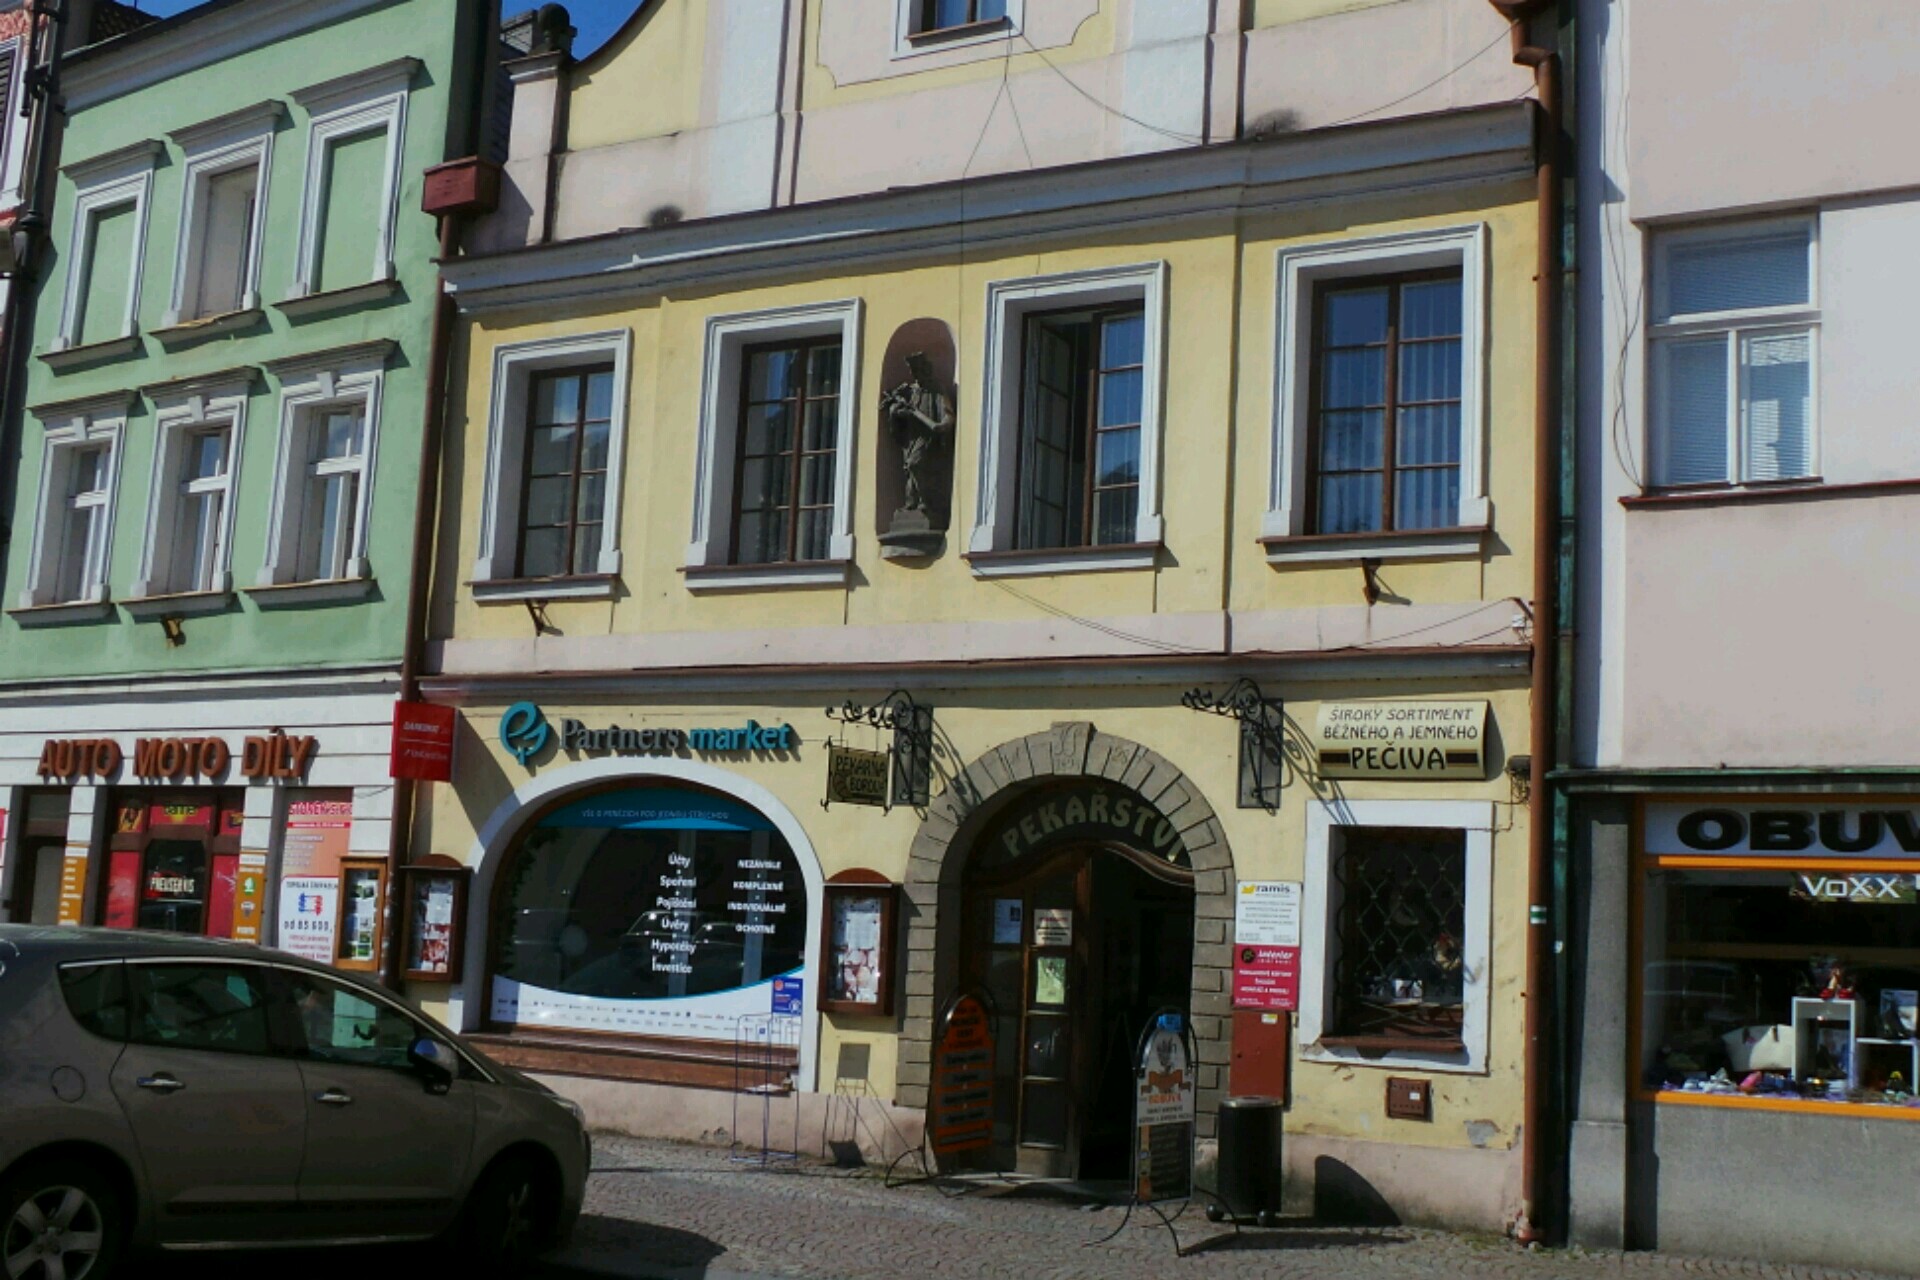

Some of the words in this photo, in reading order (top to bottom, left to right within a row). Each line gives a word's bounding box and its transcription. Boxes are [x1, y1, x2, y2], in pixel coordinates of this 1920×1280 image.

[1386, 708, 1474, 721] SORTIMENT
[560, 717, 678, 750] Partners
[688, 719, 790, 750] market
[1393, 726, 1405, 739] A
[36, 738, 123, 778] AUTO
[133, 737, 231, 778] MOTO
[1351, 741, 1446, 770] PEČIVA
[668, 852, 691, 868] Účty
[1256, 884, 1291, 893] ramis
